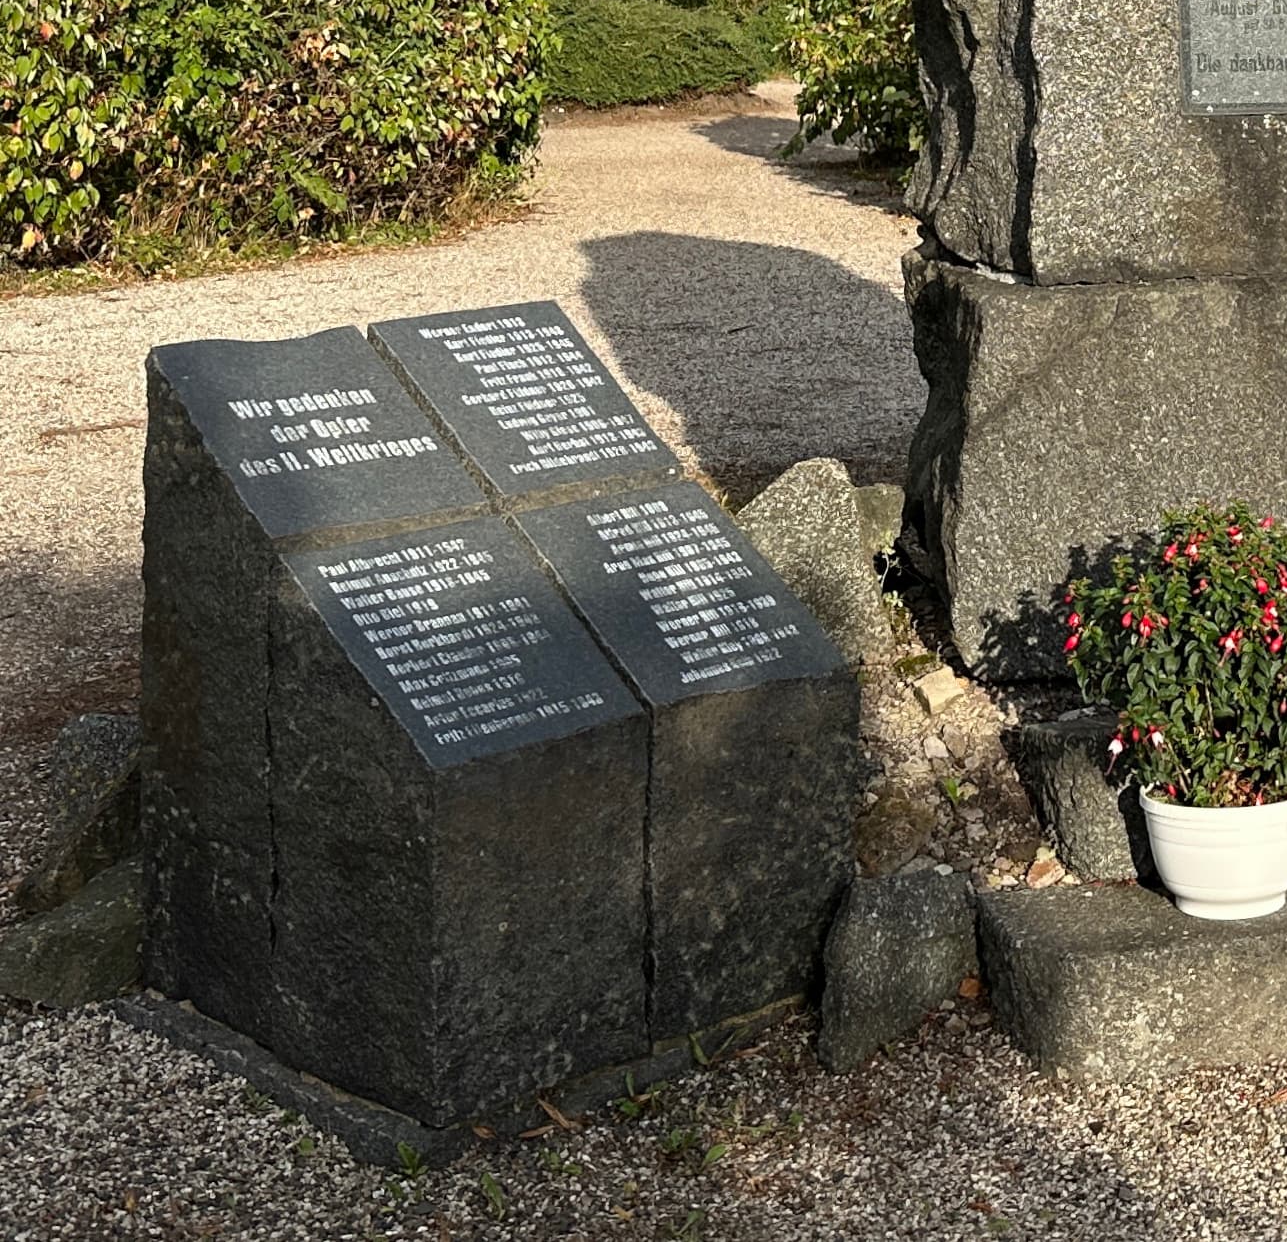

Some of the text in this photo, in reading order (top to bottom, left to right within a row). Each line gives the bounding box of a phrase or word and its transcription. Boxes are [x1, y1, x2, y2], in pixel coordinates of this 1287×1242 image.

[1209, 0, 1260, 19] August
[419, 325, 462, 339] Werner
[469, 334, 506, 346] Fiedler
[478, 346, 517, 359] Fiedler
[474, 363, 498, 374] Paul
[481, 376, 506, 388] Fritz
[228, 389, 377, 420] Wir gedenken
[461, 390, 507, 406] Gerhard
[489, 404, 517, 416] Heinz
[270, 416, 371, 443] der Opfer
[498, 415, 537, 430] Ludwig
[522, 428, 550, 442] Willy
[240, 436, 438, 478] des II. Weltkrieges
[510, 461, 540, 475] Erich
[318, 562, 348, 578] Paul
[346, 551, 402, 572] Albrecht
[330, 575, 374, 594] Helmut
[341, 591, 386, 610] Walter
[353, 611, 380, 627] Otto
[658, 613, 701, 632] Werner
[365, 622, 415, 643] Werner
[399, 676, 428, 693] Max
